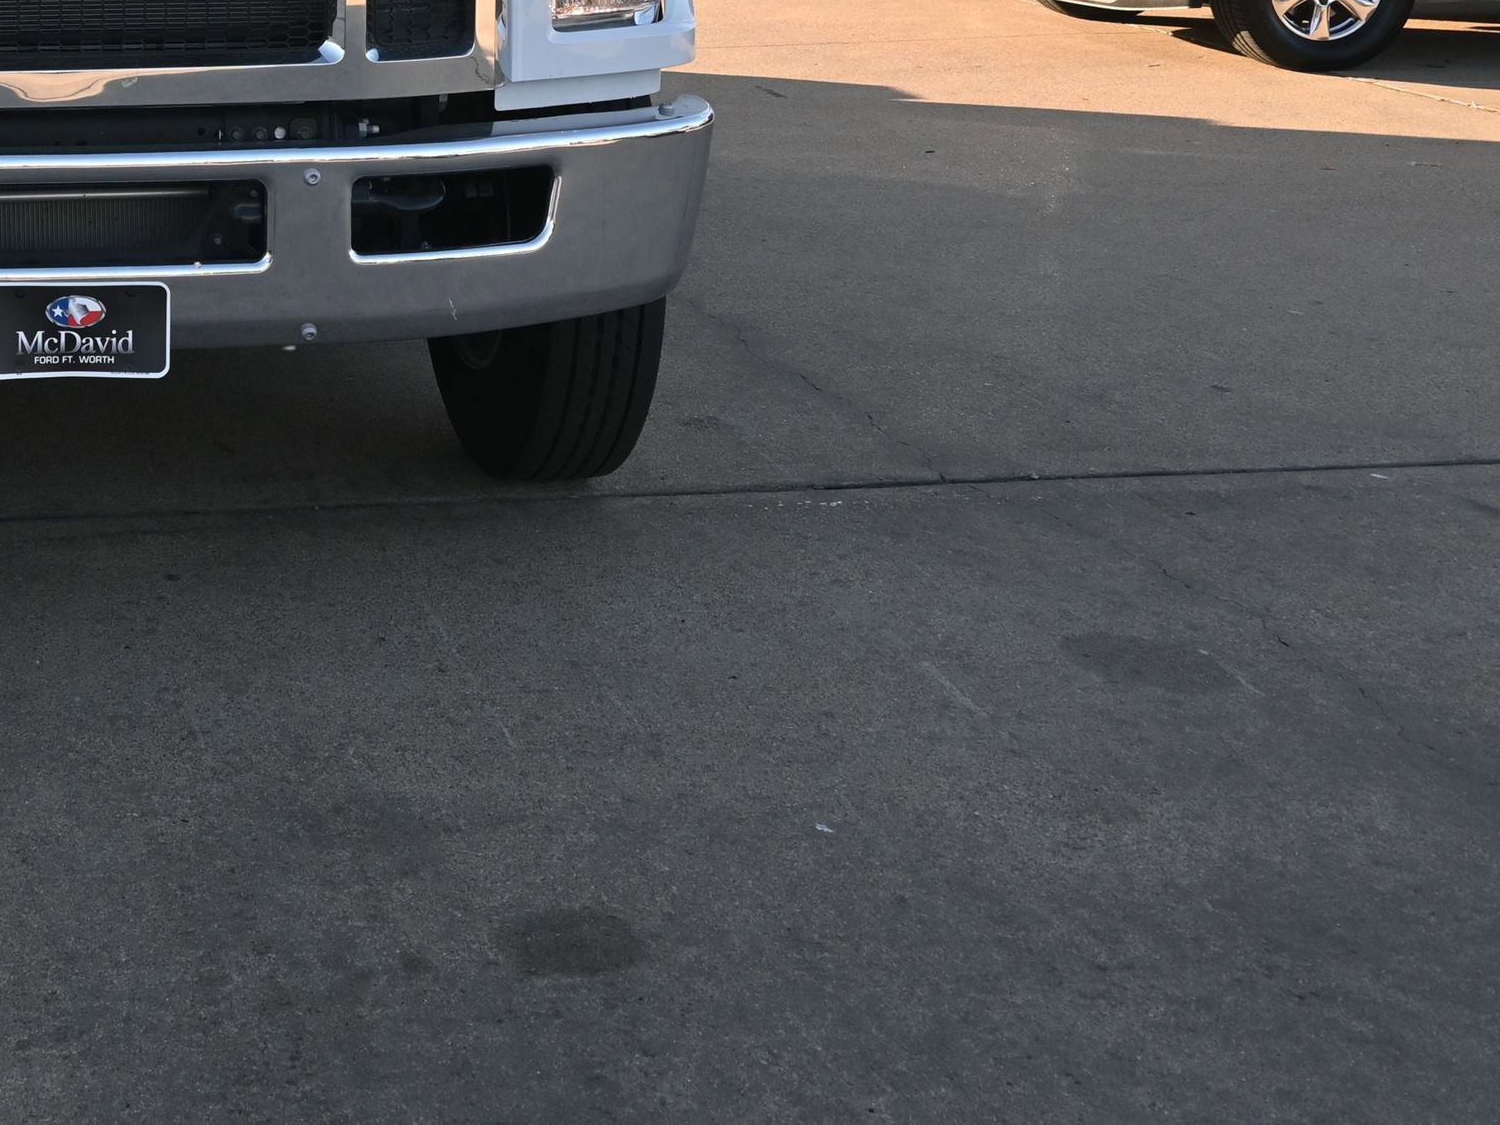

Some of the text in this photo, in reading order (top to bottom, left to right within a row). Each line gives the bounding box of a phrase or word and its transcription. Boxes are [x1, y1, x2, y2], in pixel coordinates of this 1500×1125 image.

[15, 329, 135, 355] McDavid
[34, 355, 115, 365] FORD FT. WORTH
